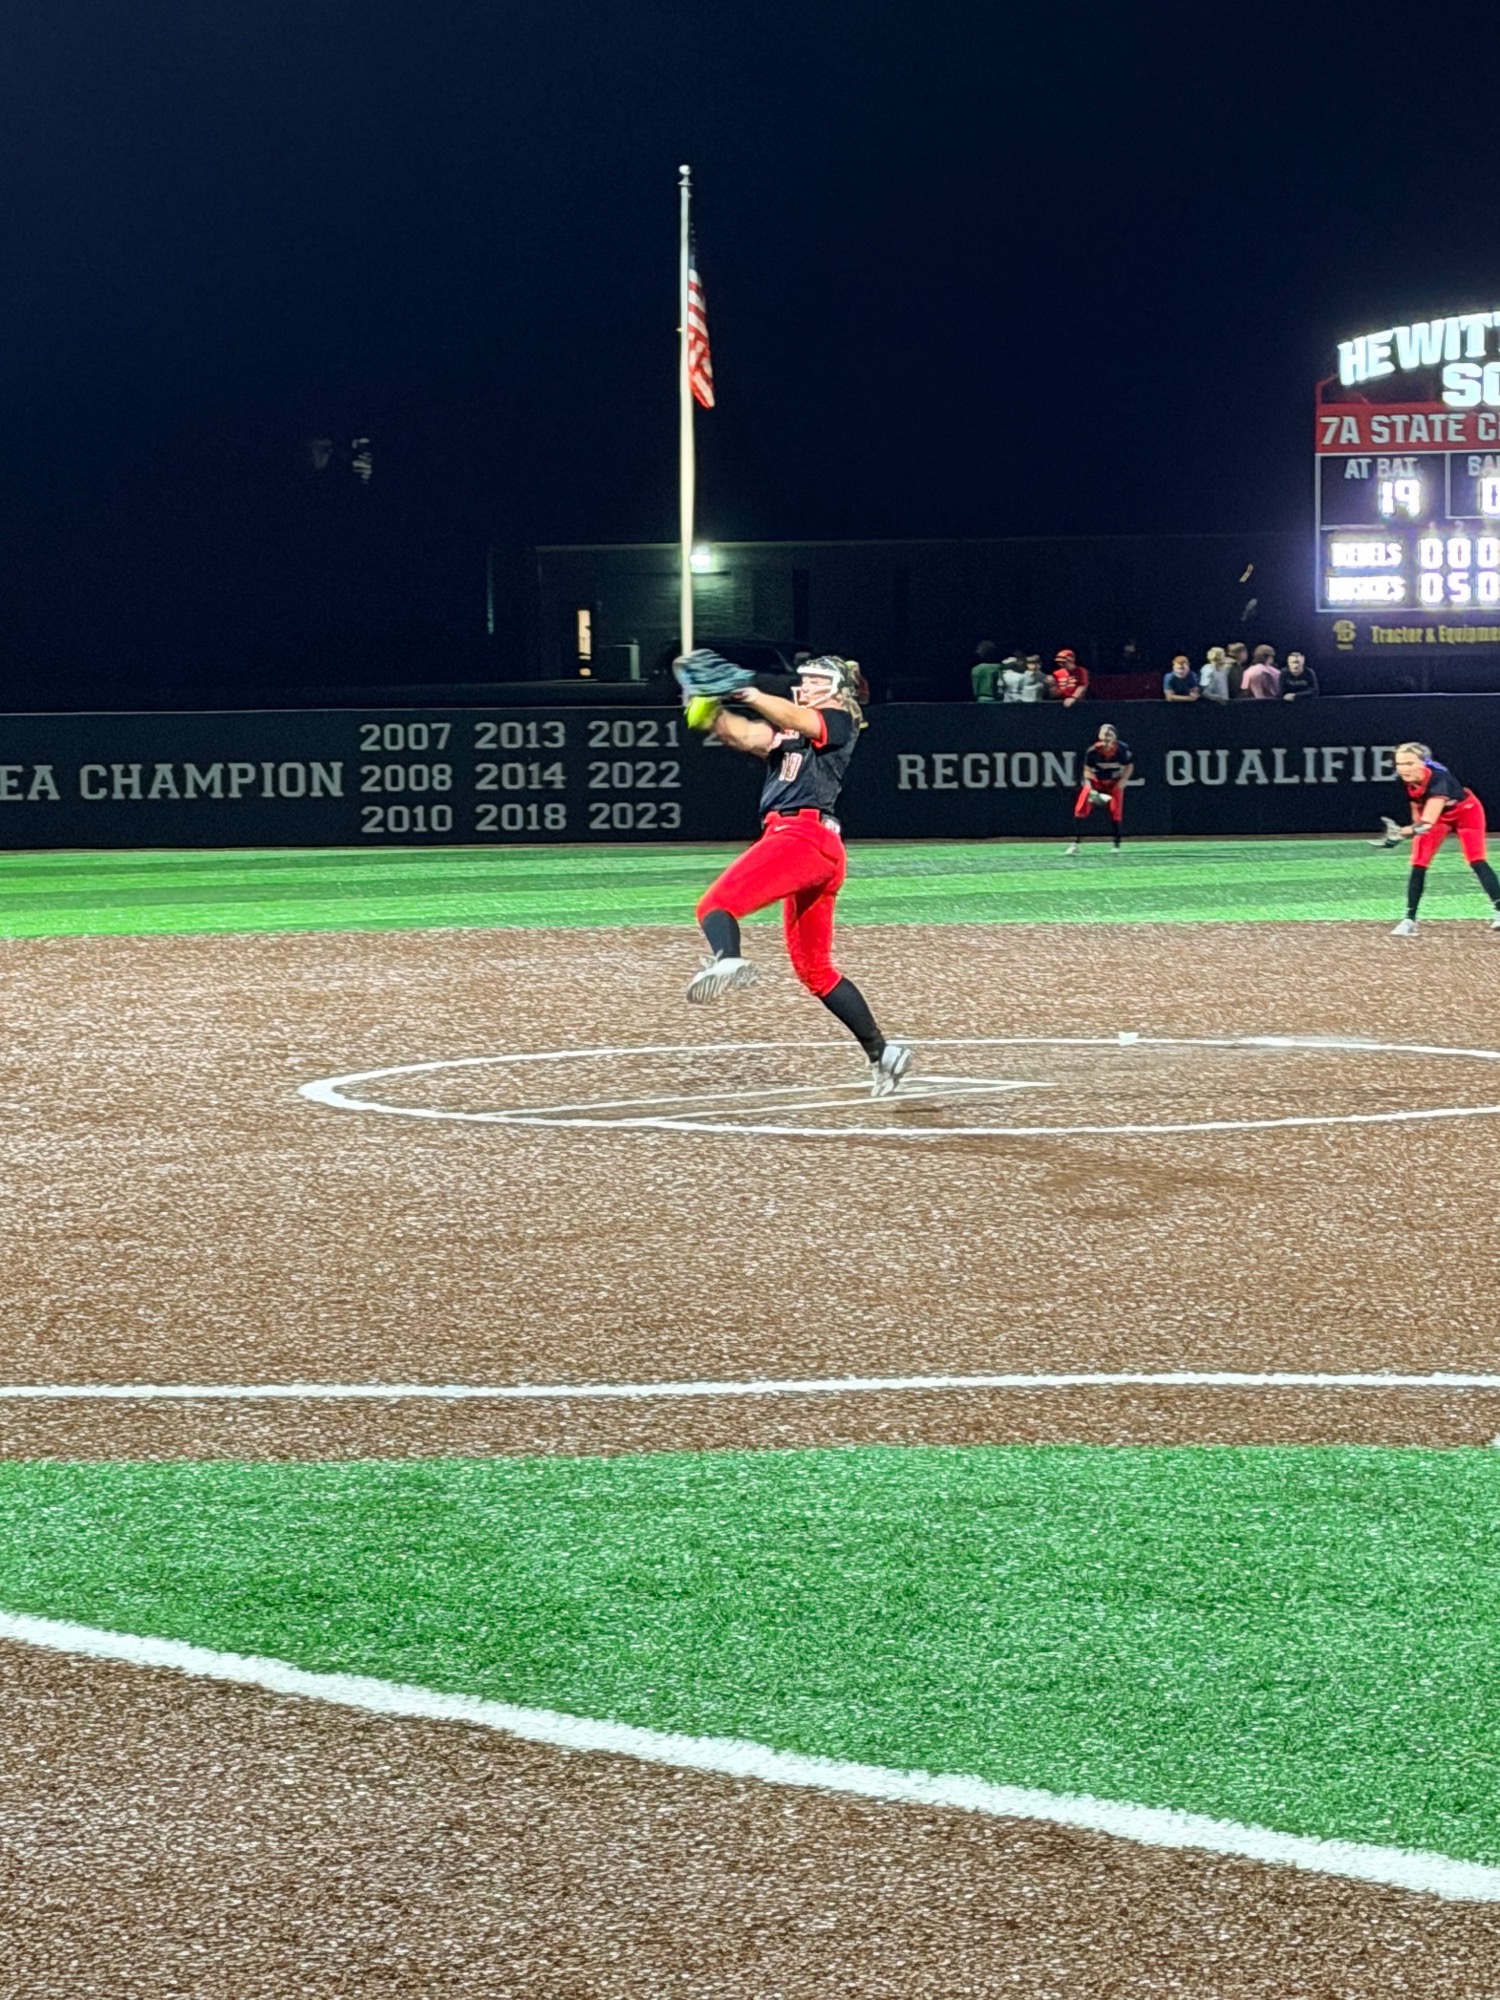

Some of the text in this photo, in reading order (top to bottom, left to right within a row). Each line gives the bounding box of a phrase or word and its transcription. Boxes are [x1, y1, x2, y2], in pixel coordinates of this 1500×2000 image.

[1337, 311, 1500, 386] HEWIT
[1320, 412, 1500, 445] 7A STATE C
[1344, 457, 1418, 480] AT BAT
[1467, 455, 1500, 477] BA
[1380, 479, 1421, 516] 19
[359, 722, 452, 751] 2007
[474, 721, 566, 749] 2013
[588, 720, 680, 748] 2021
[79, 761, 344, 800] CHAMPION
[360, 761, 681, 792] 2008 2014 2022
[897, 745, 1399, 790] REGION QUALIFIE
[361, 802, 681, 833] 2010 2018 2023
